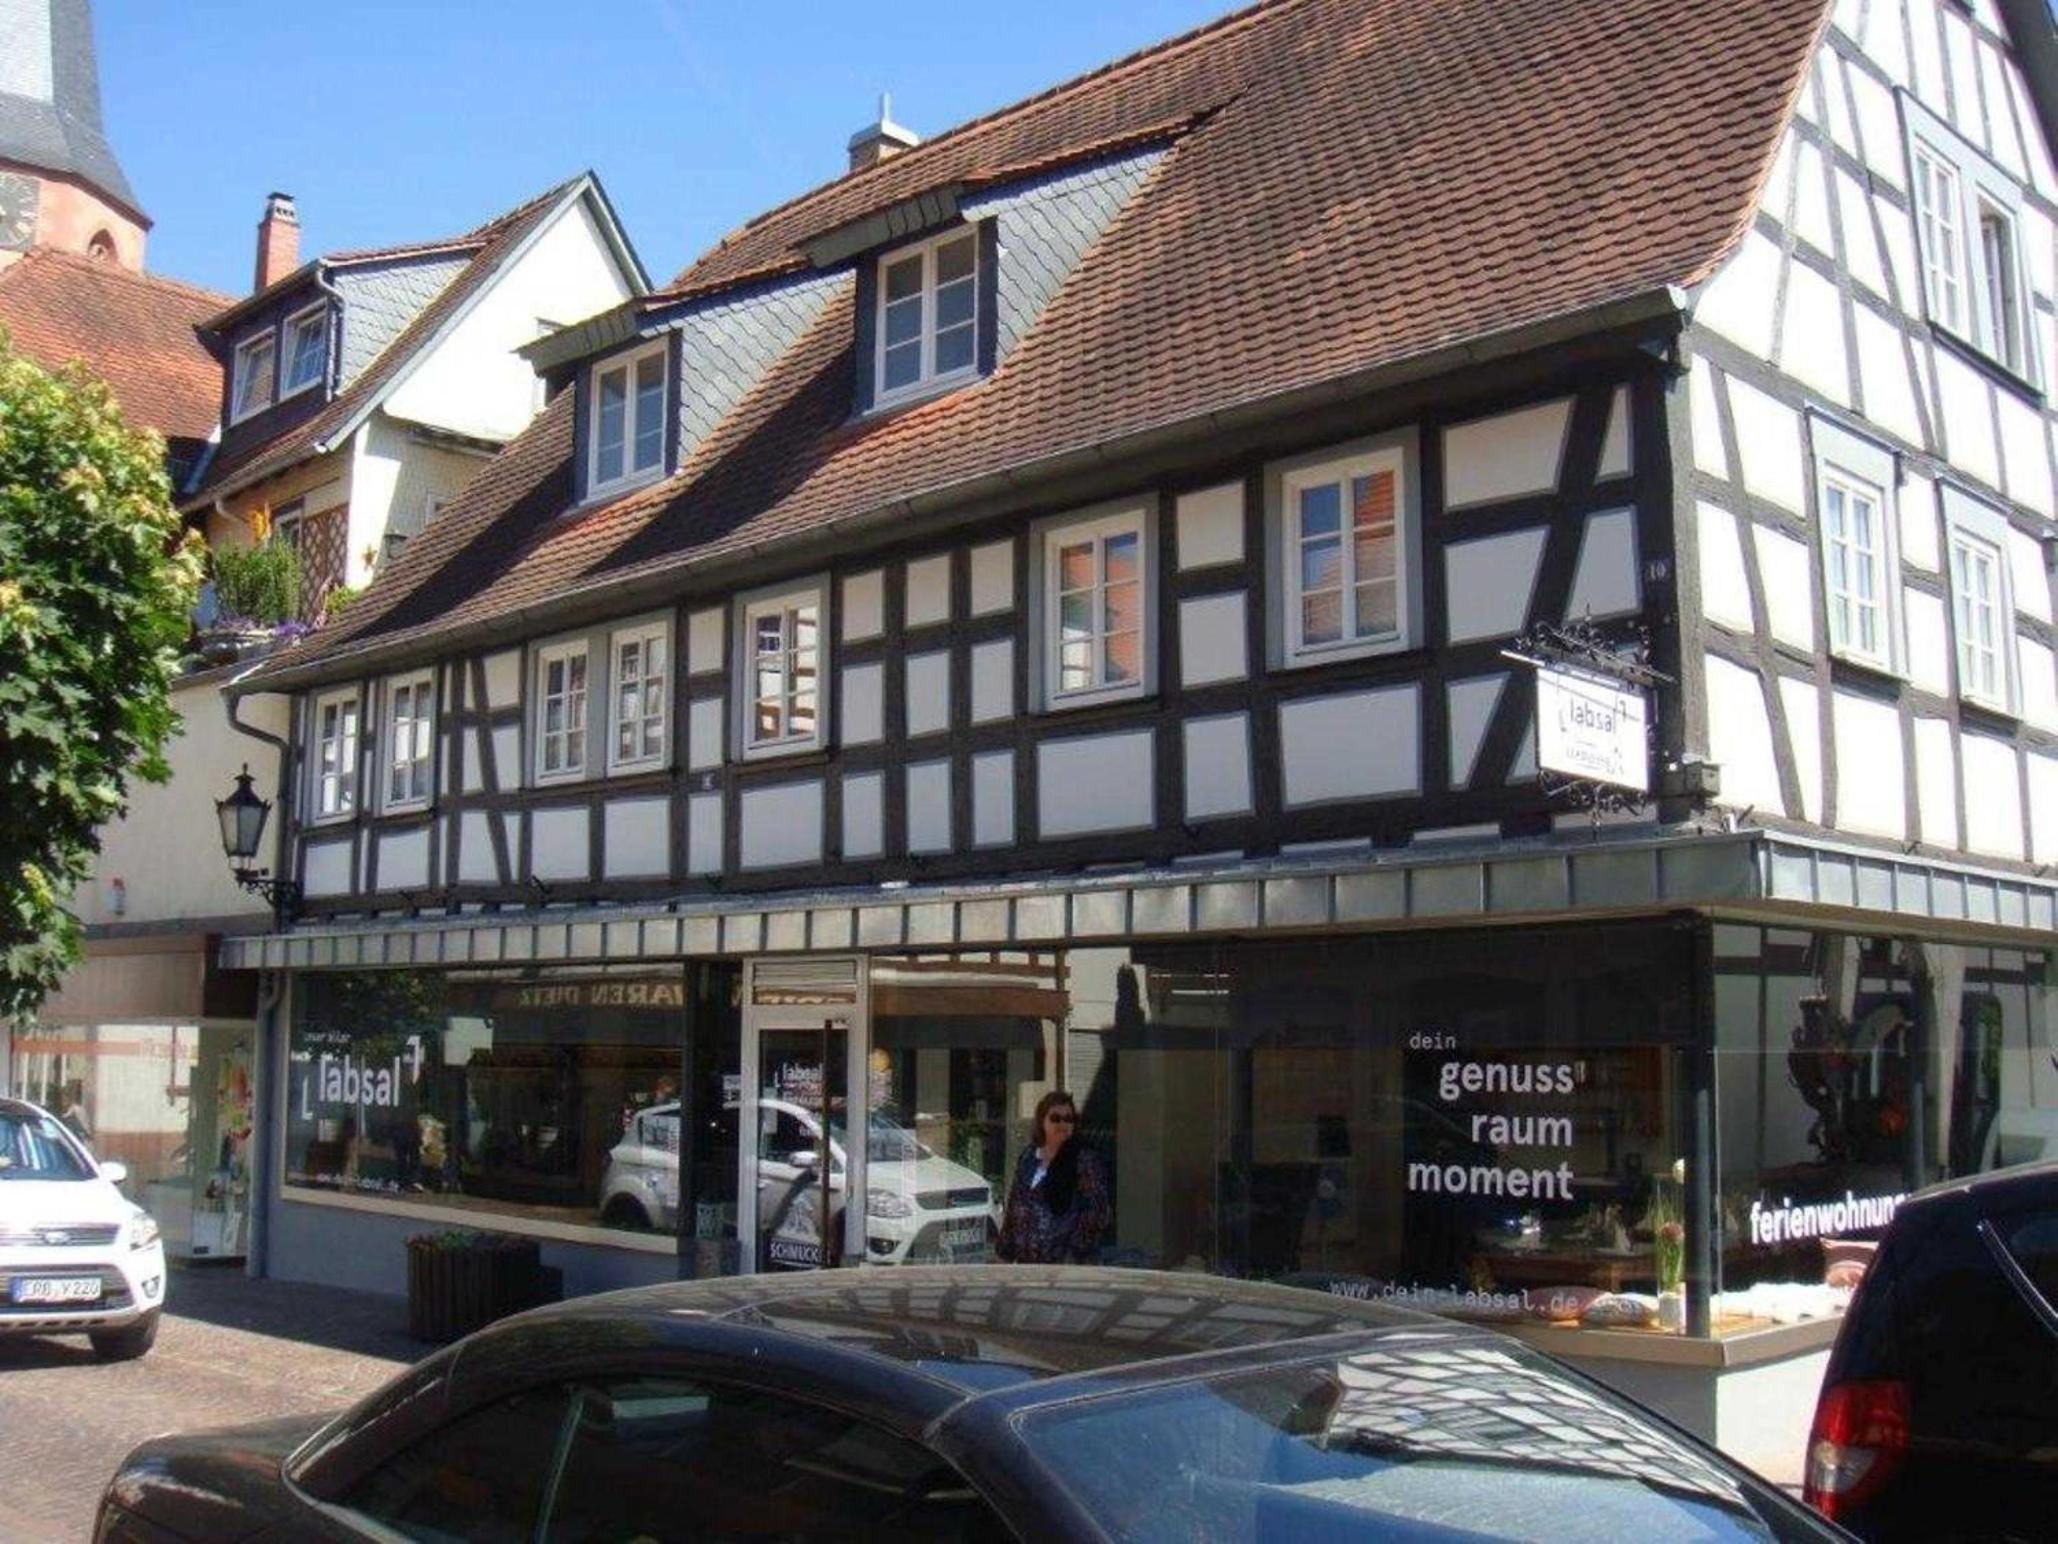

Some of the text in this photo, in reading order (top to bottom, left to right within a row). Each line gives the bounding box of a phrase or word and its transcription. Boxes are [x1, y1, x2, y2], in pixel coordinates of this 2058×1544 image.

[1570, 694, 1618, 735] labsal
[1409, 1032, 1457, 1049] dein
[320, 1053, 400, 1107] labsal
[1440, 1061, 1575, 1101] genuss
[1471, 1114, 1573, 1147] raum
[1408, 1161, 1574, 1200] moment
